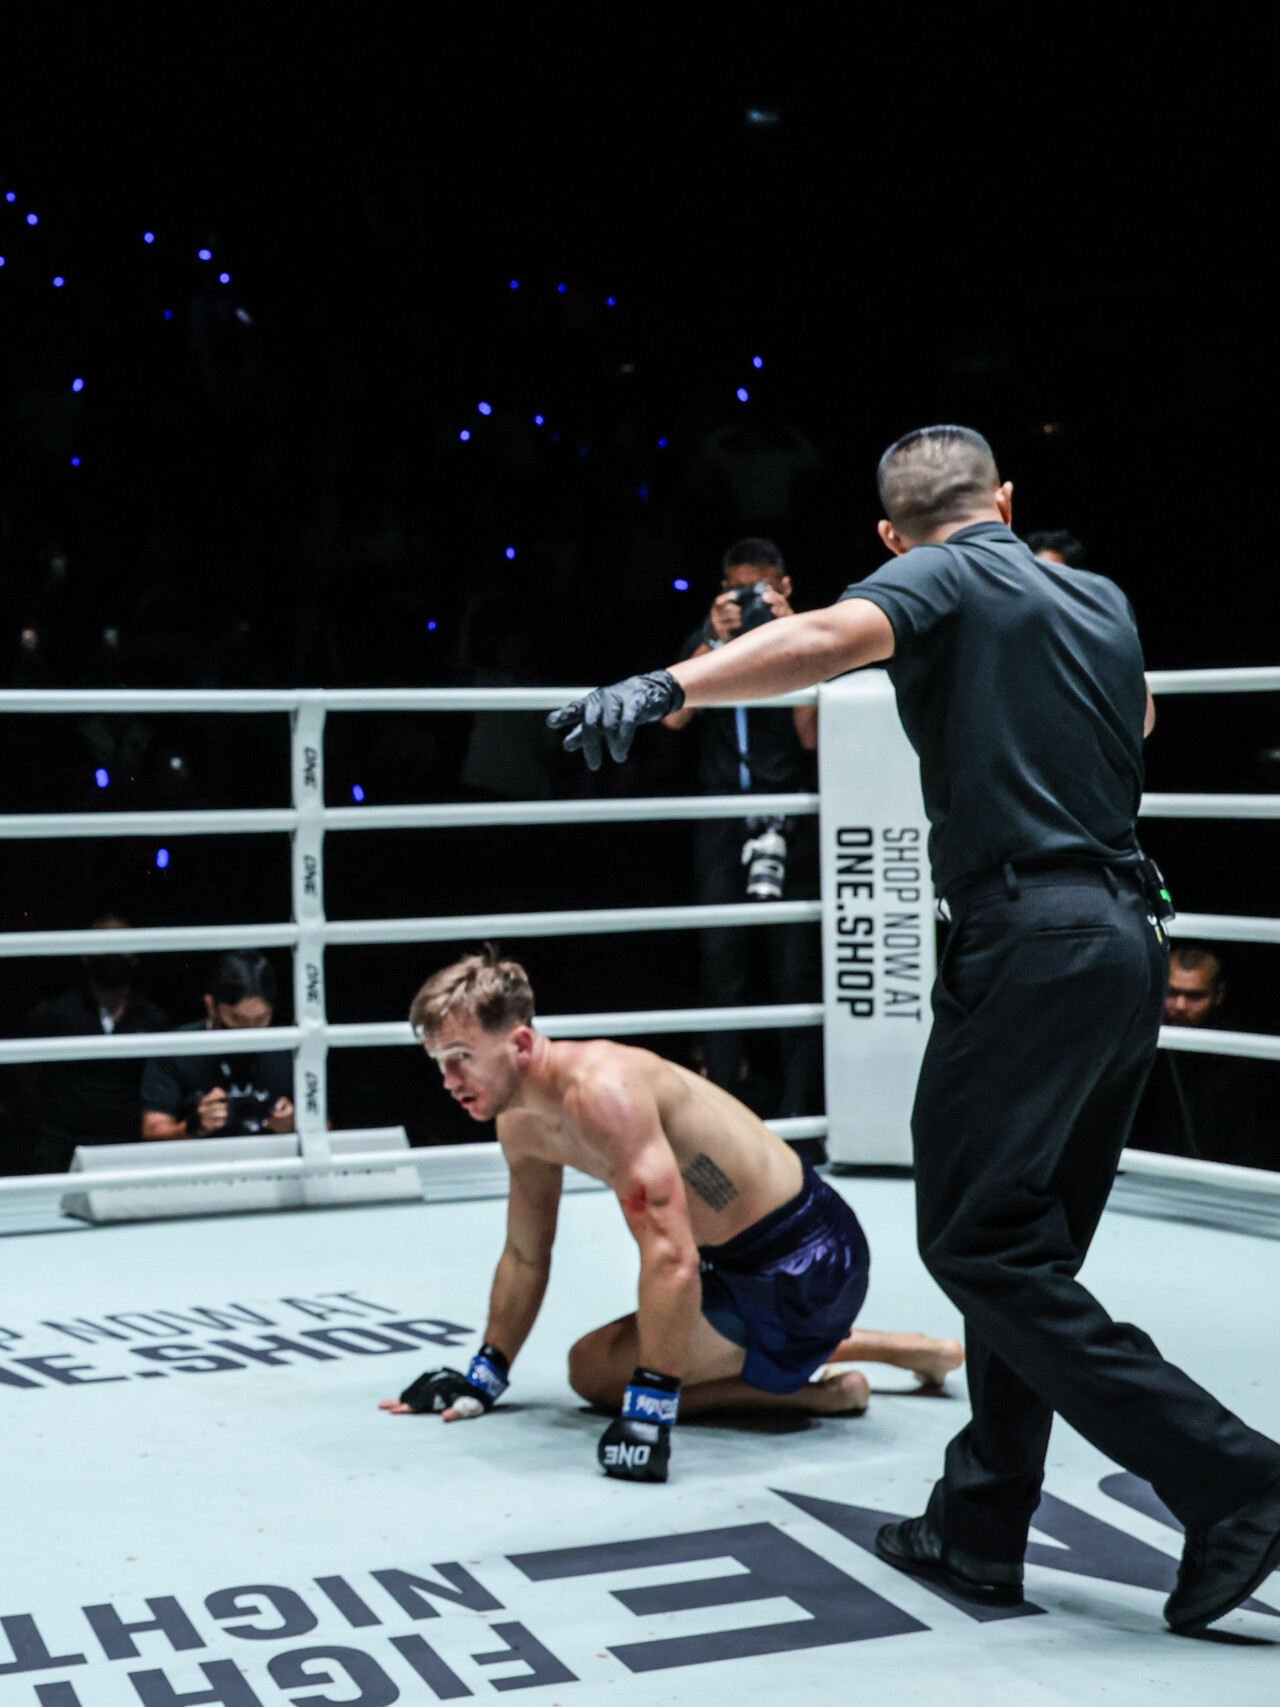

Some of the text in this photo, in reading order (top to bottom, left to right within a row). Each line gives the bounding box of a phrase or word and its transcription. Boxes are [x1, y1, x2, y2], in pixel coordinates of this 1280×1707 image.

[304, 746, 317, 789] ONE
[303, 854, 317, 898] ONE
[836, 828, 874, 1017] ONE.SHOP
[882, 828, 921, 1023] SHOP NOW AT
[37, 1303, 280, 1344] NOW
[277, 1290, 402, 1322] AT
[603, 1441, 651, 1470] ONE
